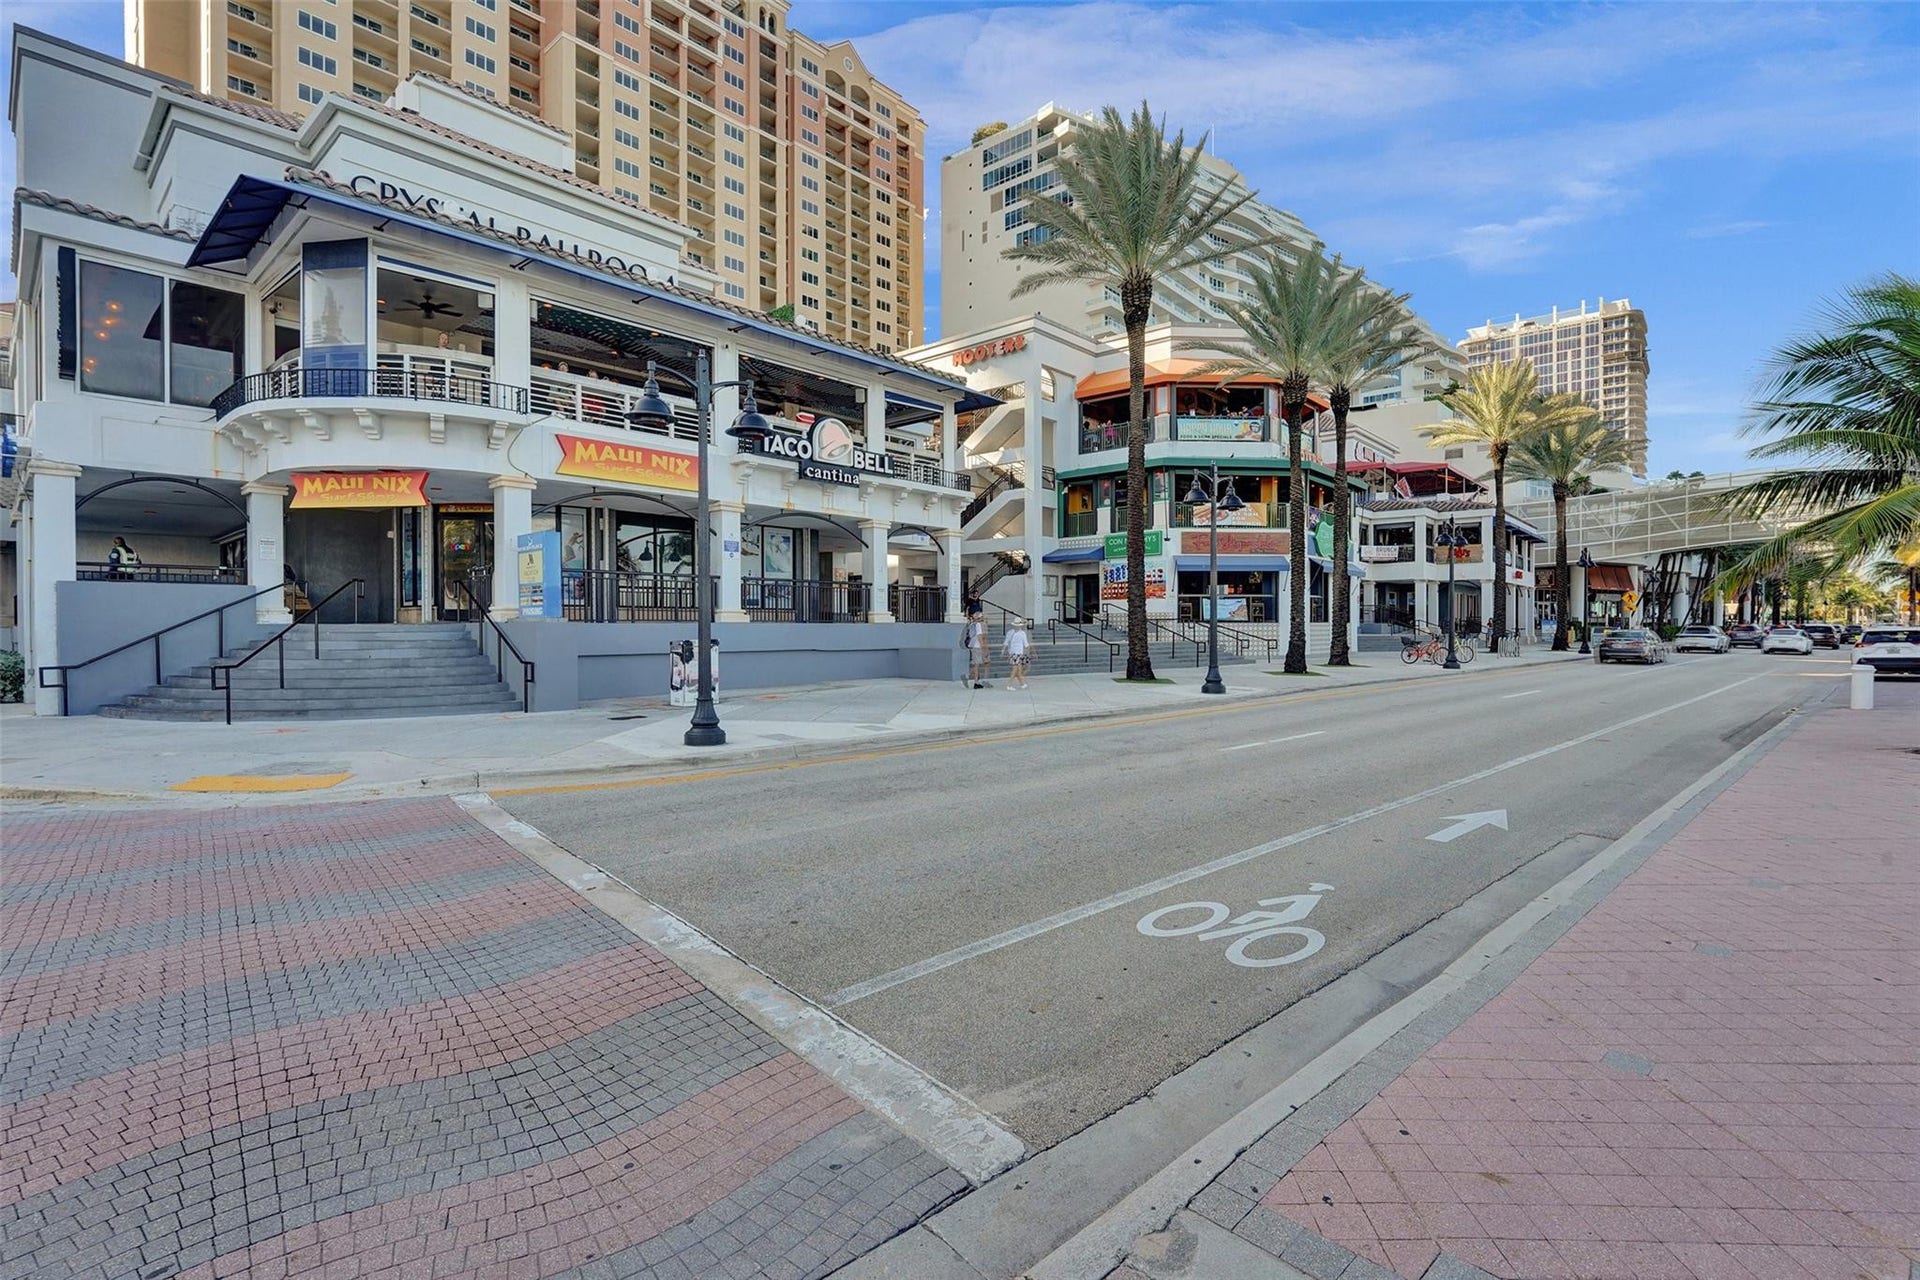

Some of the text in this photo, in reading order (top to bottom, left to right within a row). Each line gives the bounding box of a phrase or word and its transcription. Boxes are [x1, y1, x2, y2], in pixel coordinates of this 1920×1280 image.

[574, 441, 691, 478] MAUI NIX
[763, 434, 893, 474] TACO BELL
[302, 476, 413, 497] MAUI NIX
[805, 466, 860, 485] cantina
